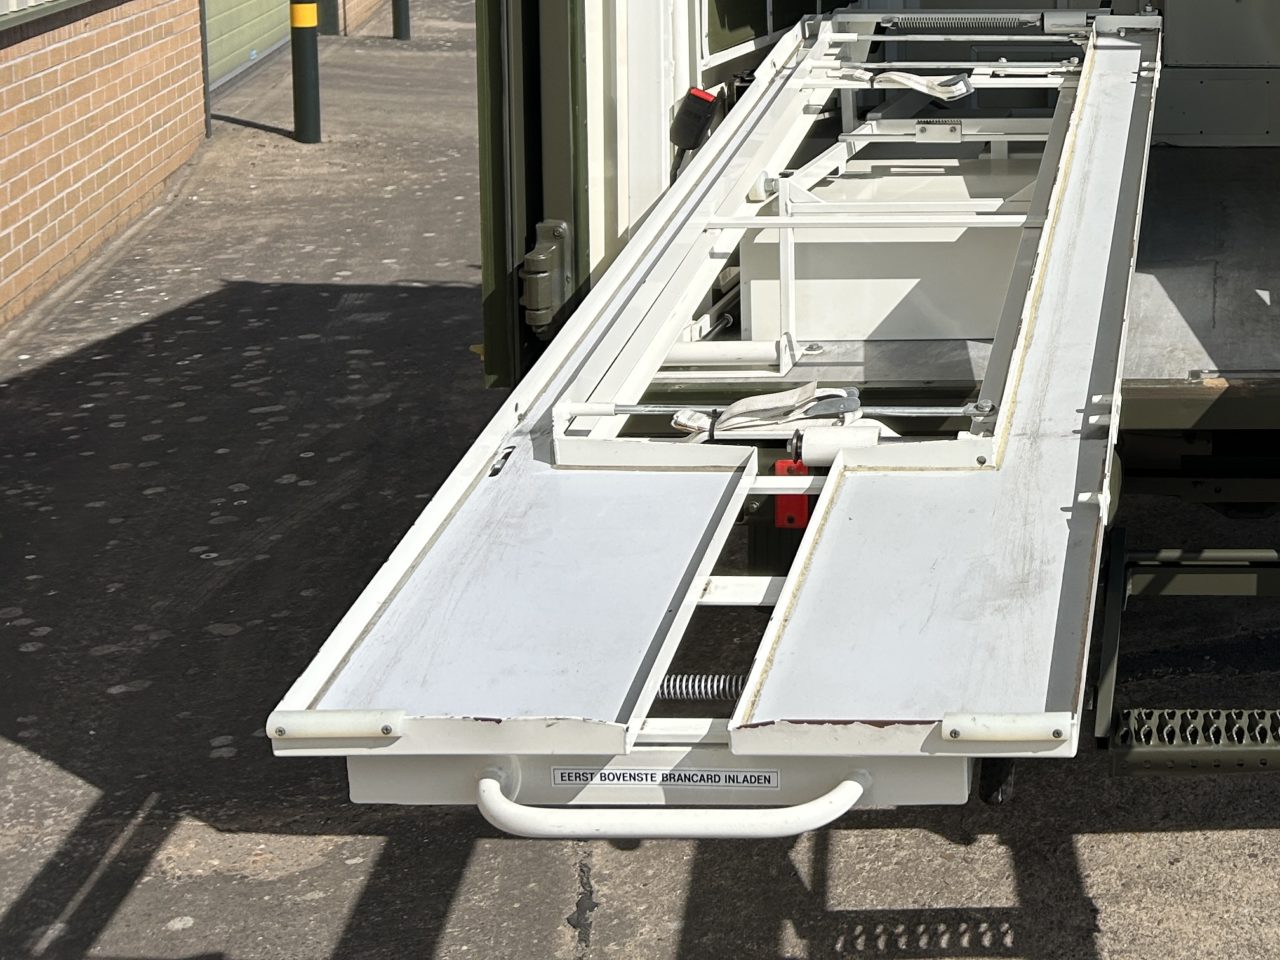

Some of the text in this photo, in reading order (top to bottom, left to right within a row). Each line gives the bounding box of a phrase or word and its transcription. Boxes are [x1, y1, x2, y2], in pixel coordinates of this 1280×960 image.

[560, 772, 771, 784] EERST BOVENSTE BRANCARD INLADEN
